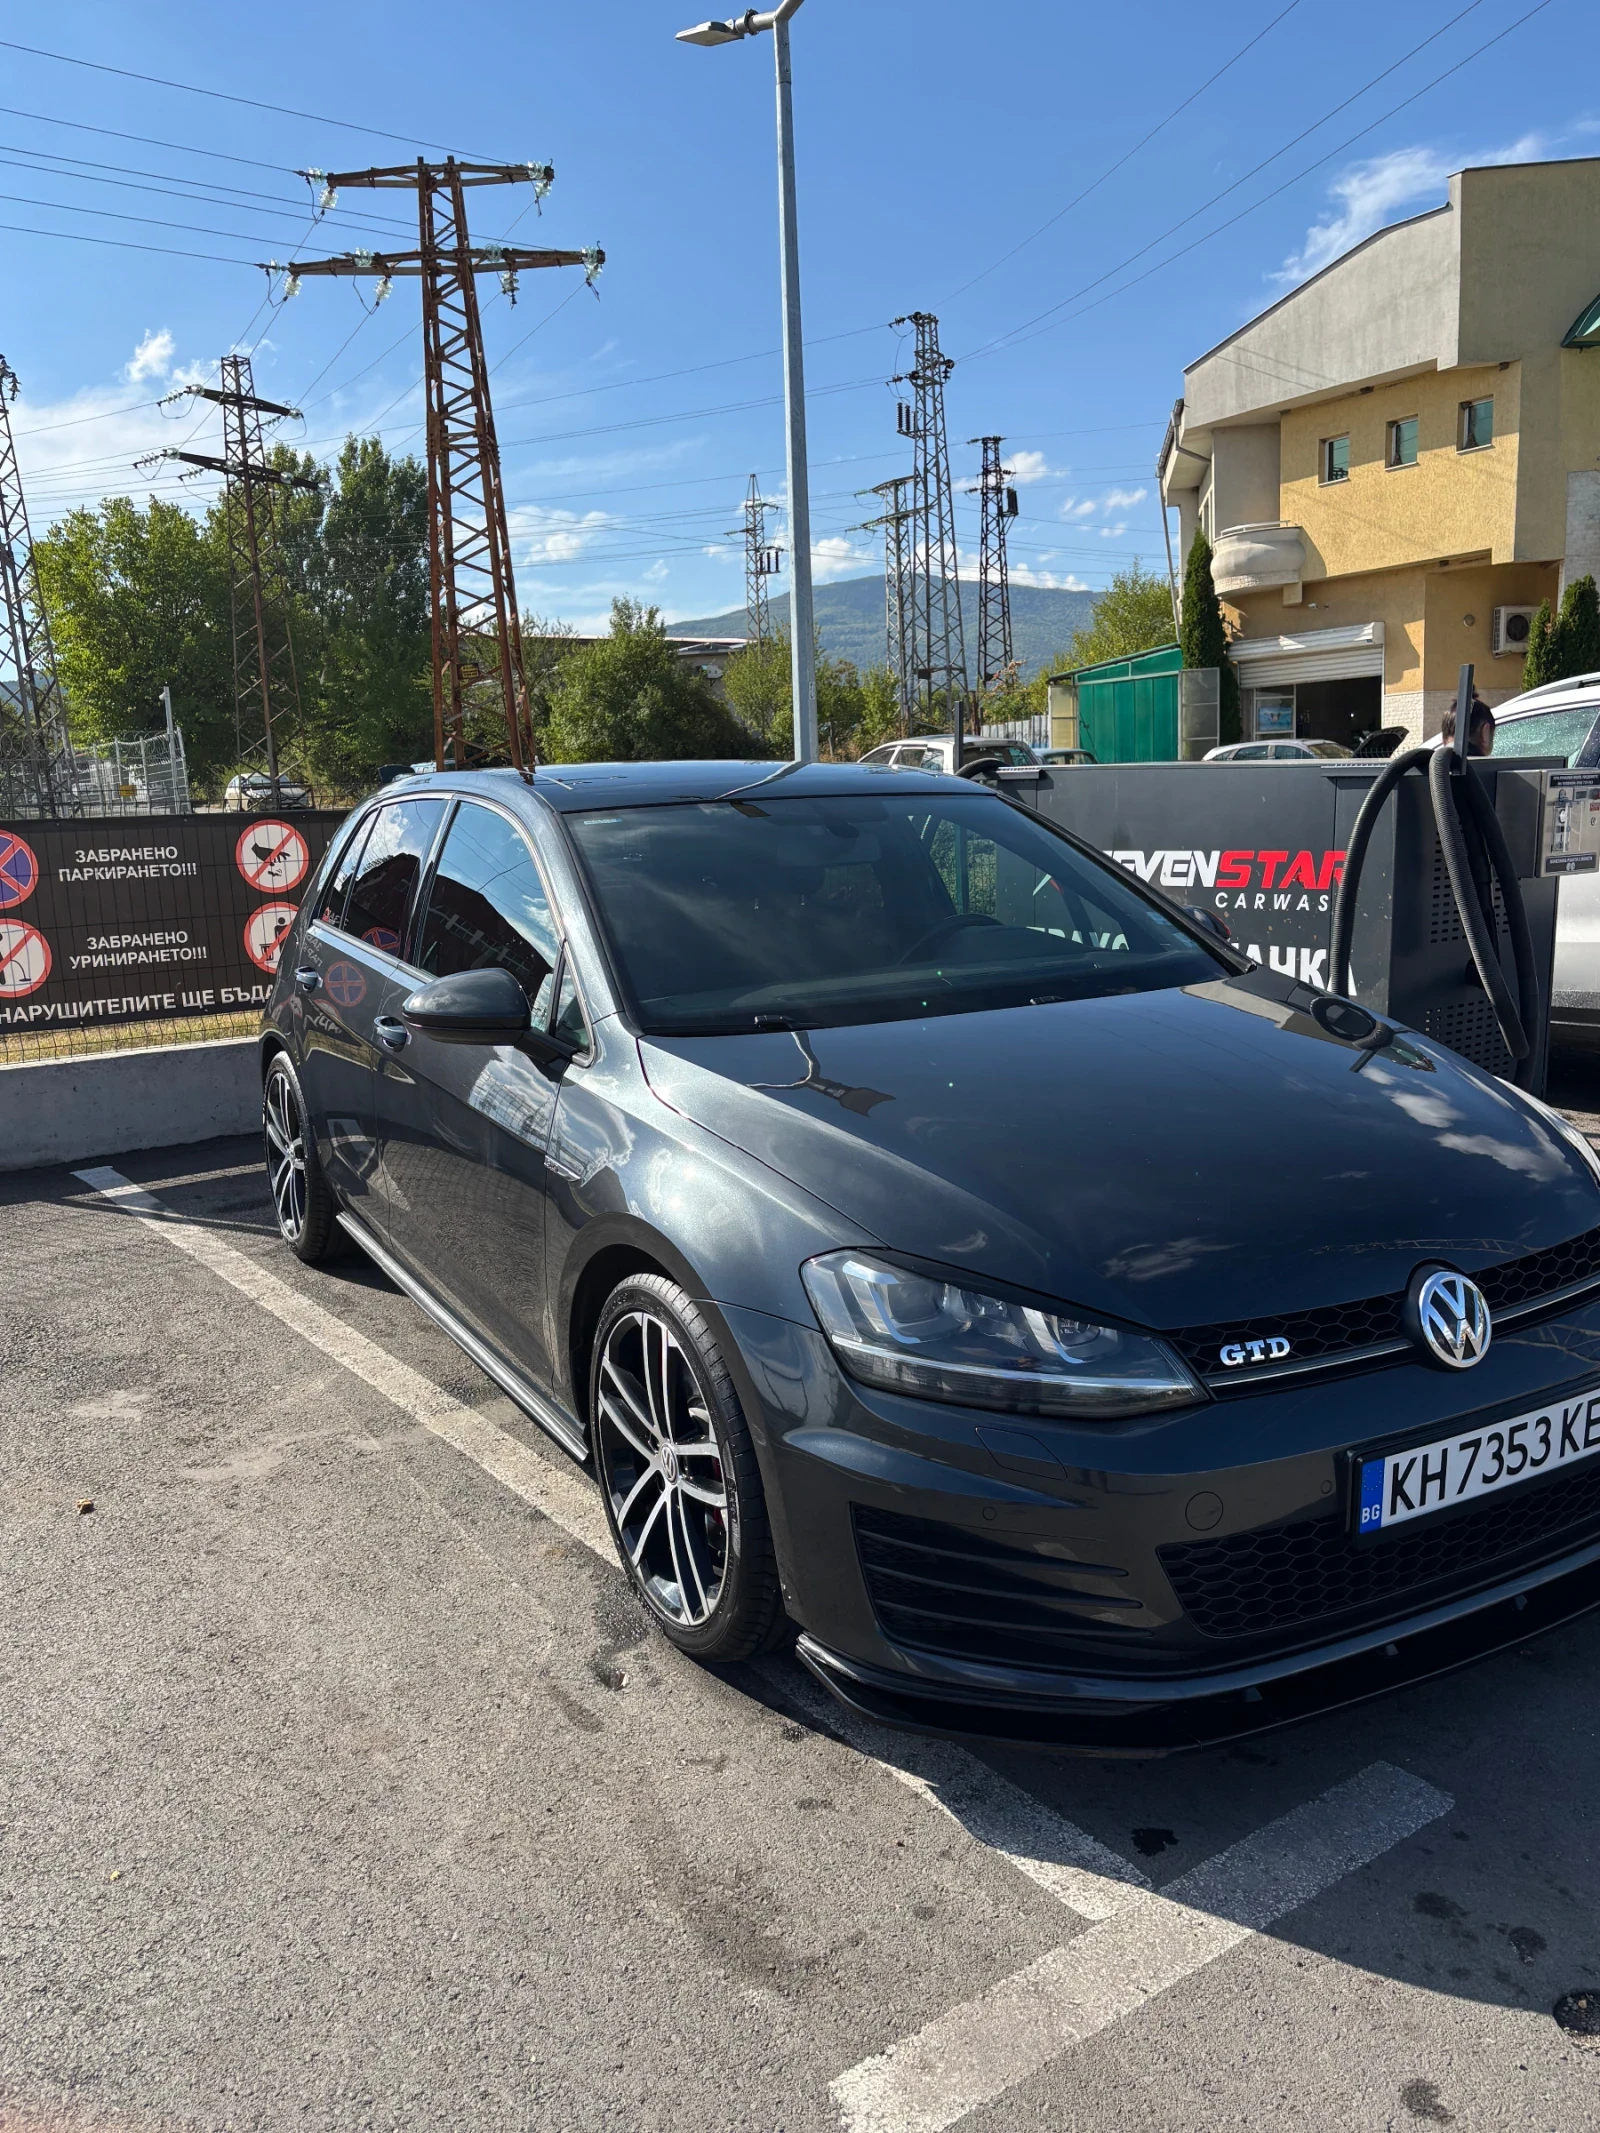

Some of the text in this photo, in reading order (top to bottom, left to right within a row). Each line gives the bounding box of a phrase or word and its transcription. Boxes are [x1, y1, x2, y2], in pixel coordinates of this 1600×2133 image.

[75, 846, 178, 863] ЗАБРАНЕНО
[58, 863, 197, 882] ПАРКИРАНЕТО!!!
[1102, 850, 1348, 890] EVENSTAR
[1215, 892, 1329, 912] CARWAS
[86, 930, 188, 950] ЗАБРАНЕНО
[69, 946, 207, 969] УРИНИРАНЕТО!!!
[0, 993, 176, 1025] НАРУШИТЕЛИТЕ
[181, 989, 215, 1009] ЩЕ
[1219, 1336, 1291, 1367] GTD
[1361, 1504, 1381, 1524] BG
